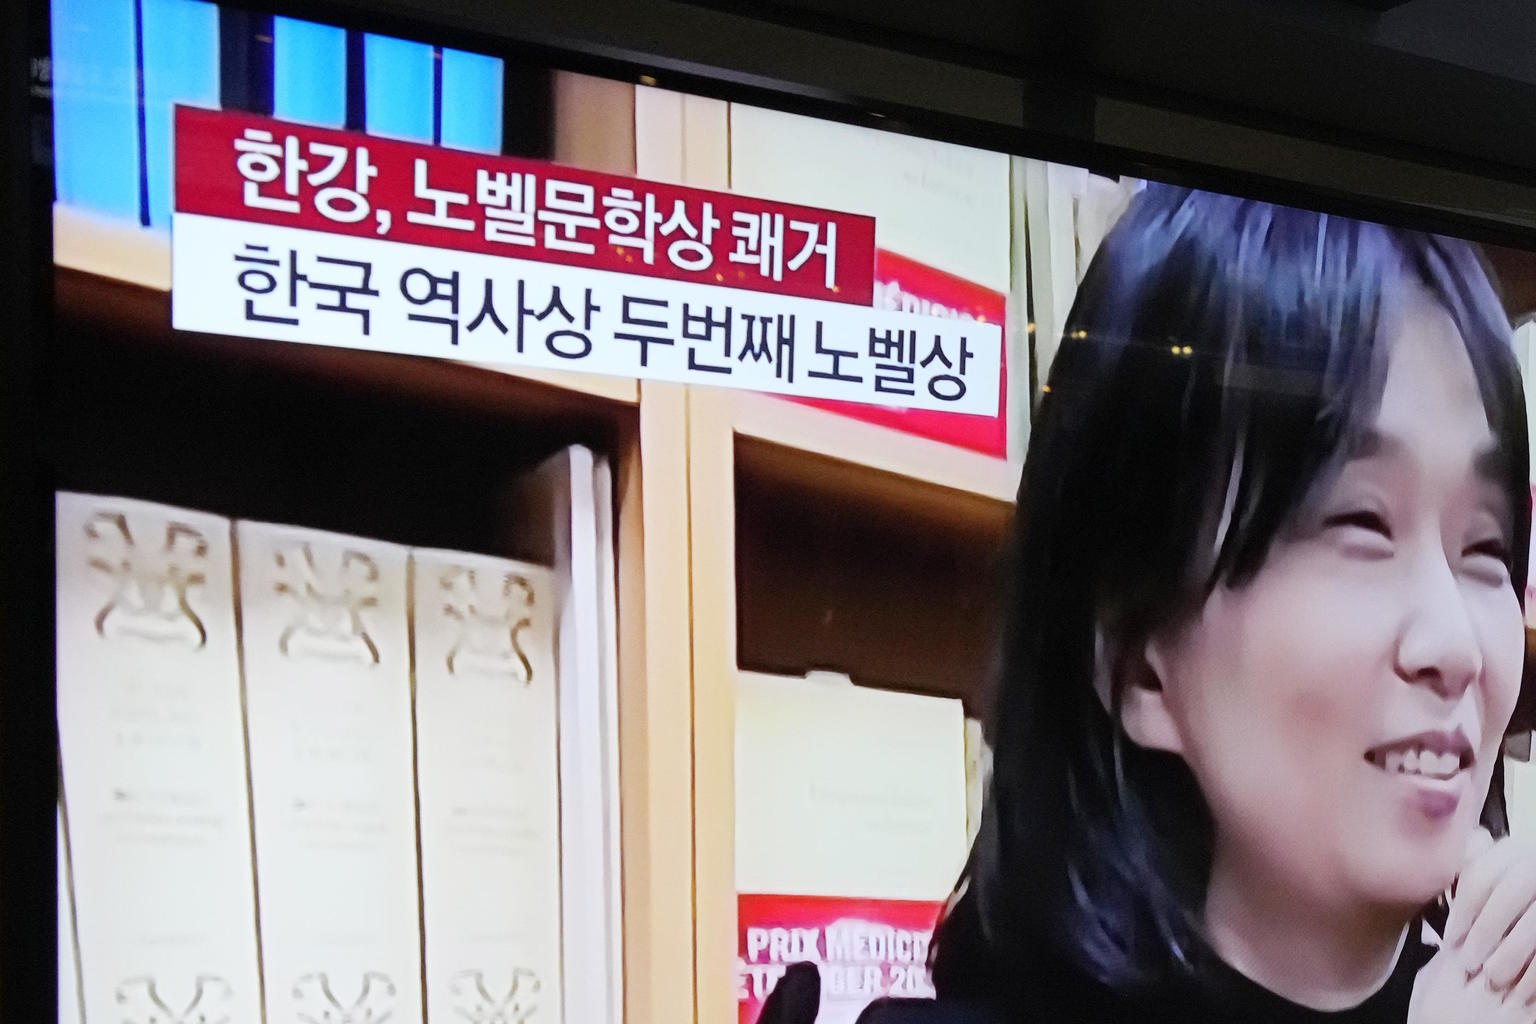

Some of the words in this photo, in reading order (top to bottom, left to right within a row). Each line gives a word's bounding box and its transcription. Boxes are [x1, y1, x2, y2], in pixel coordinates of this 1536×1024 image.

[234, 125, 390, 234] 한강,
[406, 157, 720, 271] 노벨문학상
[730, 215, 838, 293] 쾌거
[235, 240, 380, 334] 한국
[399, 266, 601, 359] 역사상
[613, 297, 796, 384] 두번째
[808, 325, 975, 402] 노벨상
